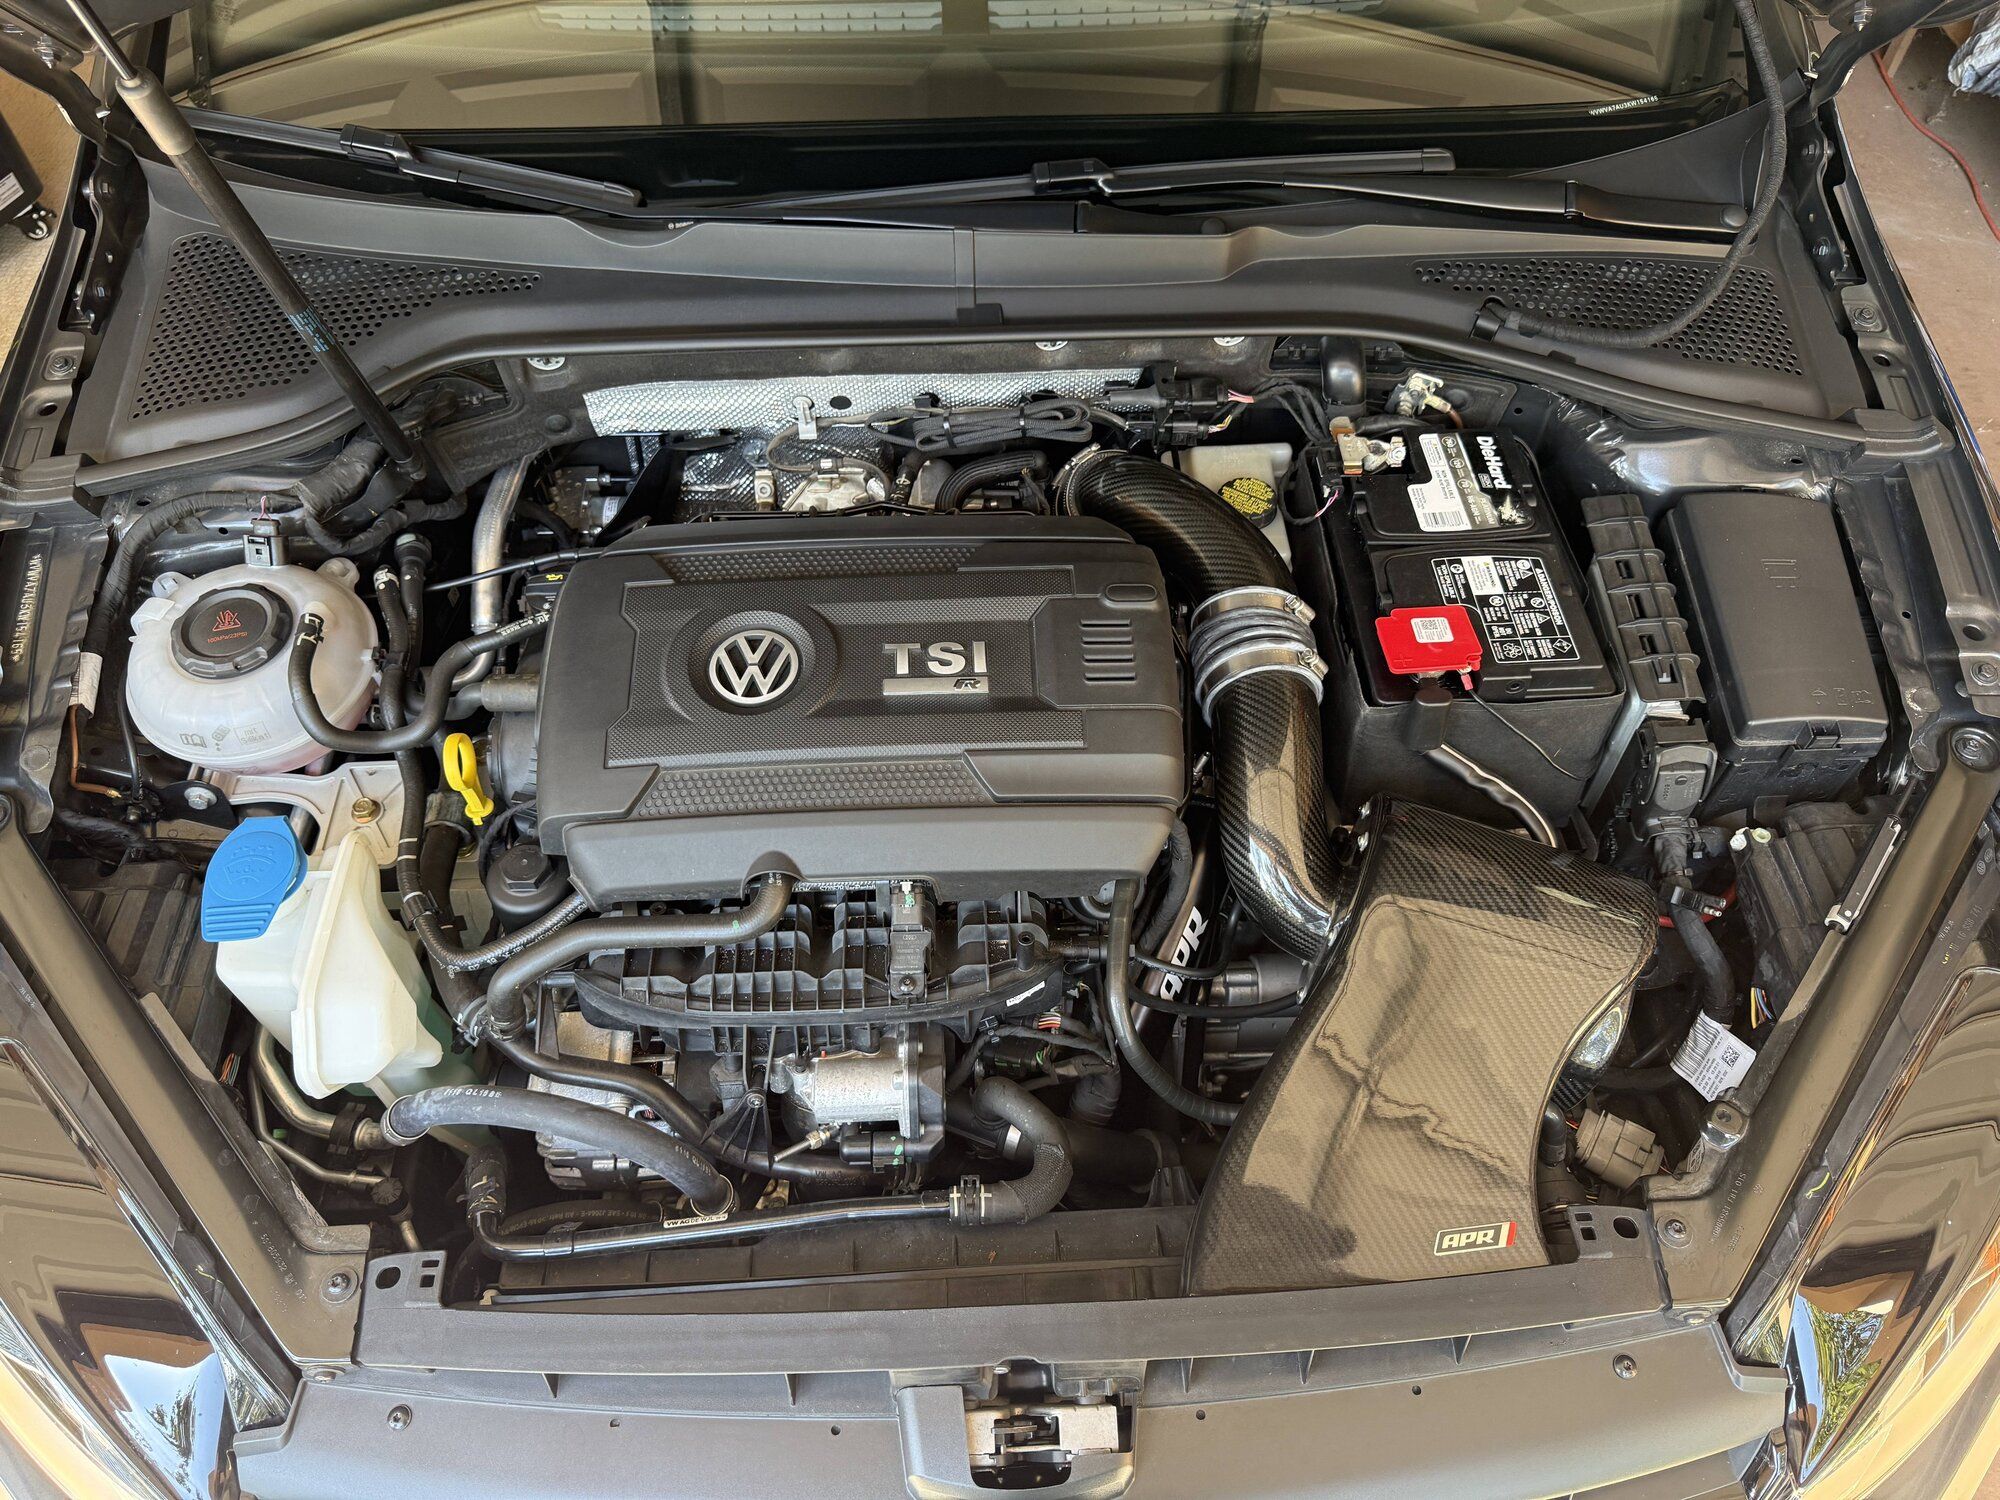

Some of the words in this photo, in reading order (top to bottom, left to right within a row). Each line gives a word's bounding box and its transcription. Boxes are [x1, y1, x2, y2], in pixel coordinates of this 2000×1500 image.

[1476, 435, 1512, 489] DieHard
[1479, 497, 1494, 524] PLATINUM
[1440, 564, 1457, 598] NON-SPILLABLE
[1536, 573, 1563, 625] DANGER/POISON
[1497, 627, 1506, 635] NOT
[883, 641, 988, 675] TSI
[1160, 905, 1208, 1002] APR
[1441, 1229, 1495, 1249] APR
